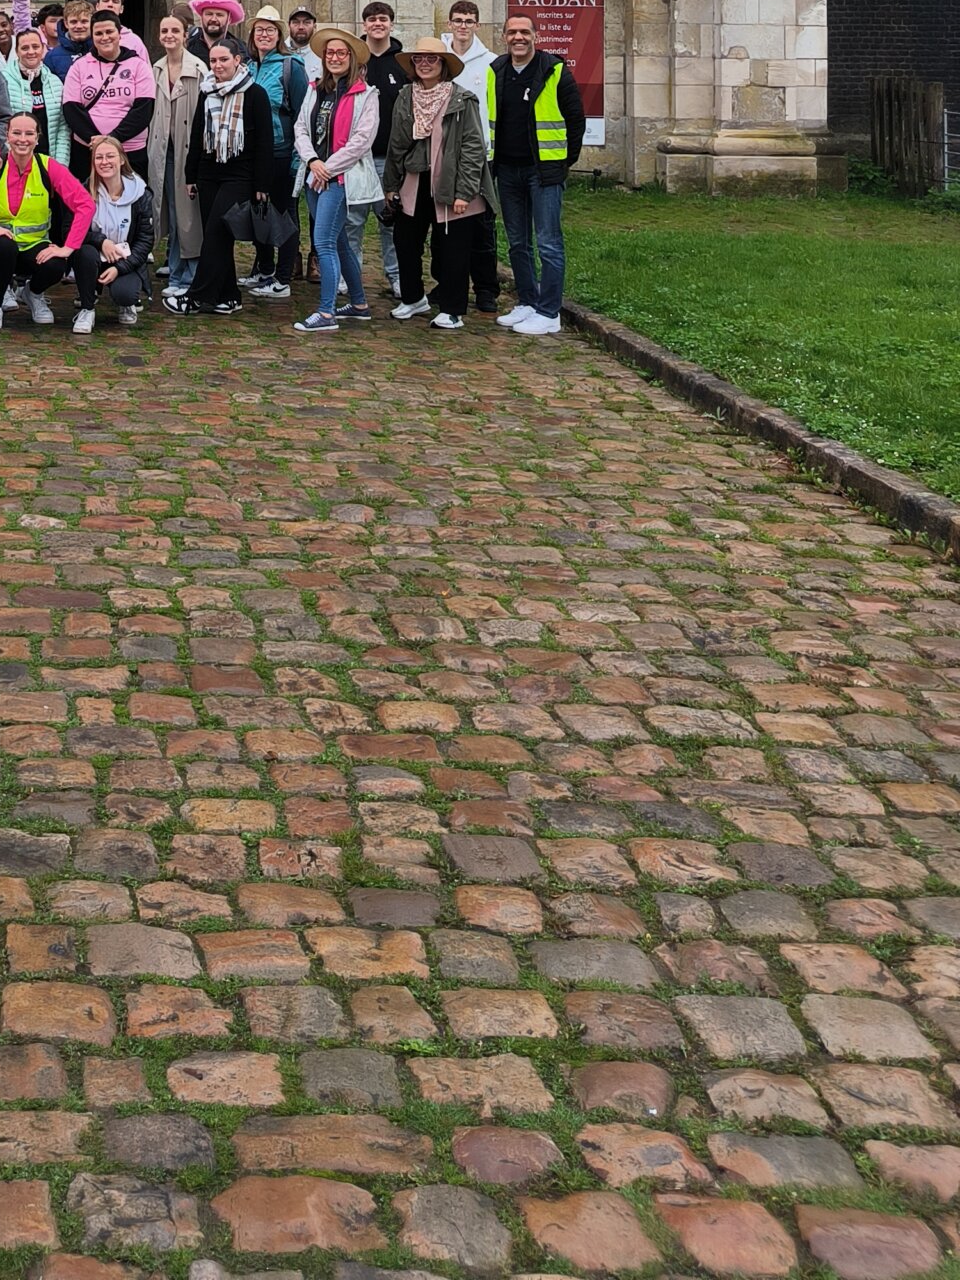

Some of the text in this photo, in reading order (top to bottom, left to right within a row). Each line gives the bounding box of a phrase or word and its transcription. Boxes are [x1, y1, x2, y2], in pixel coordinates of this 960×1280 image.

[536, 11, 563, 19] inscrites
[539, 34, 573, 43] patrimoine
[542, 47, 569, 55] mondial
[102, 86, 131, 98] XBTO
